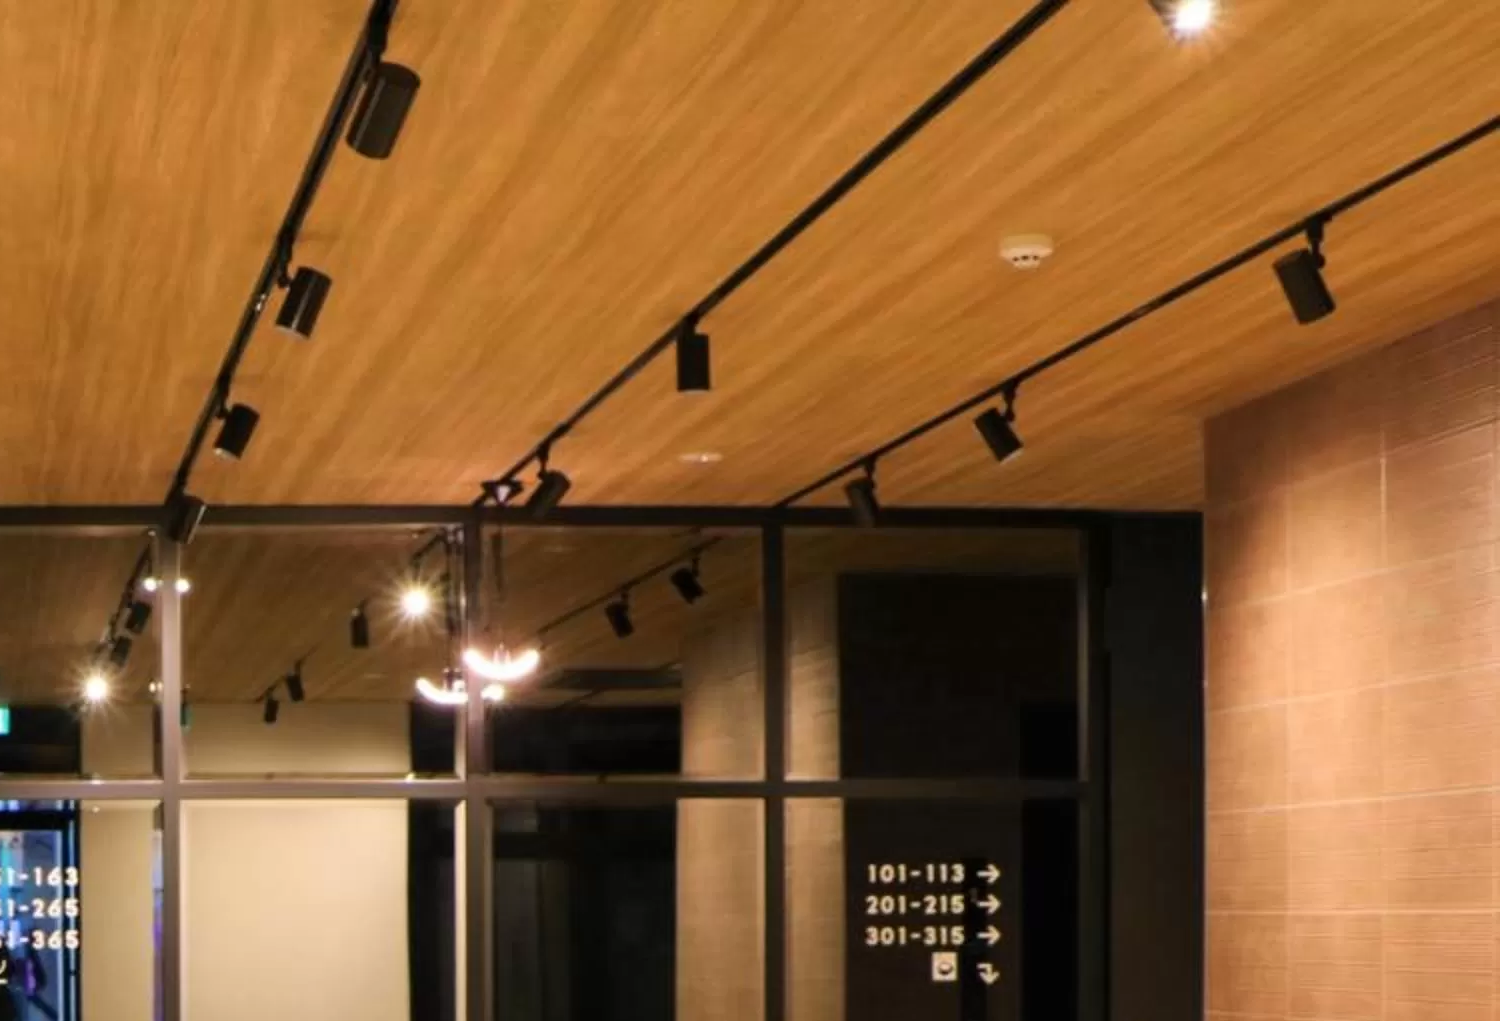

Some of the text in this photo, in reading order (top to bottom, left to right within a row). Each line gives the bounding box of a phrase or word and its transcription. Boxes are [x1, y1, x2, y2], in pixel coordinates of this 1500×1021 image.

[867, 863, 966, 883] 101-113
[865, 895, 966, 915] 201-215
[865, 926, 966, 945] 301-315
